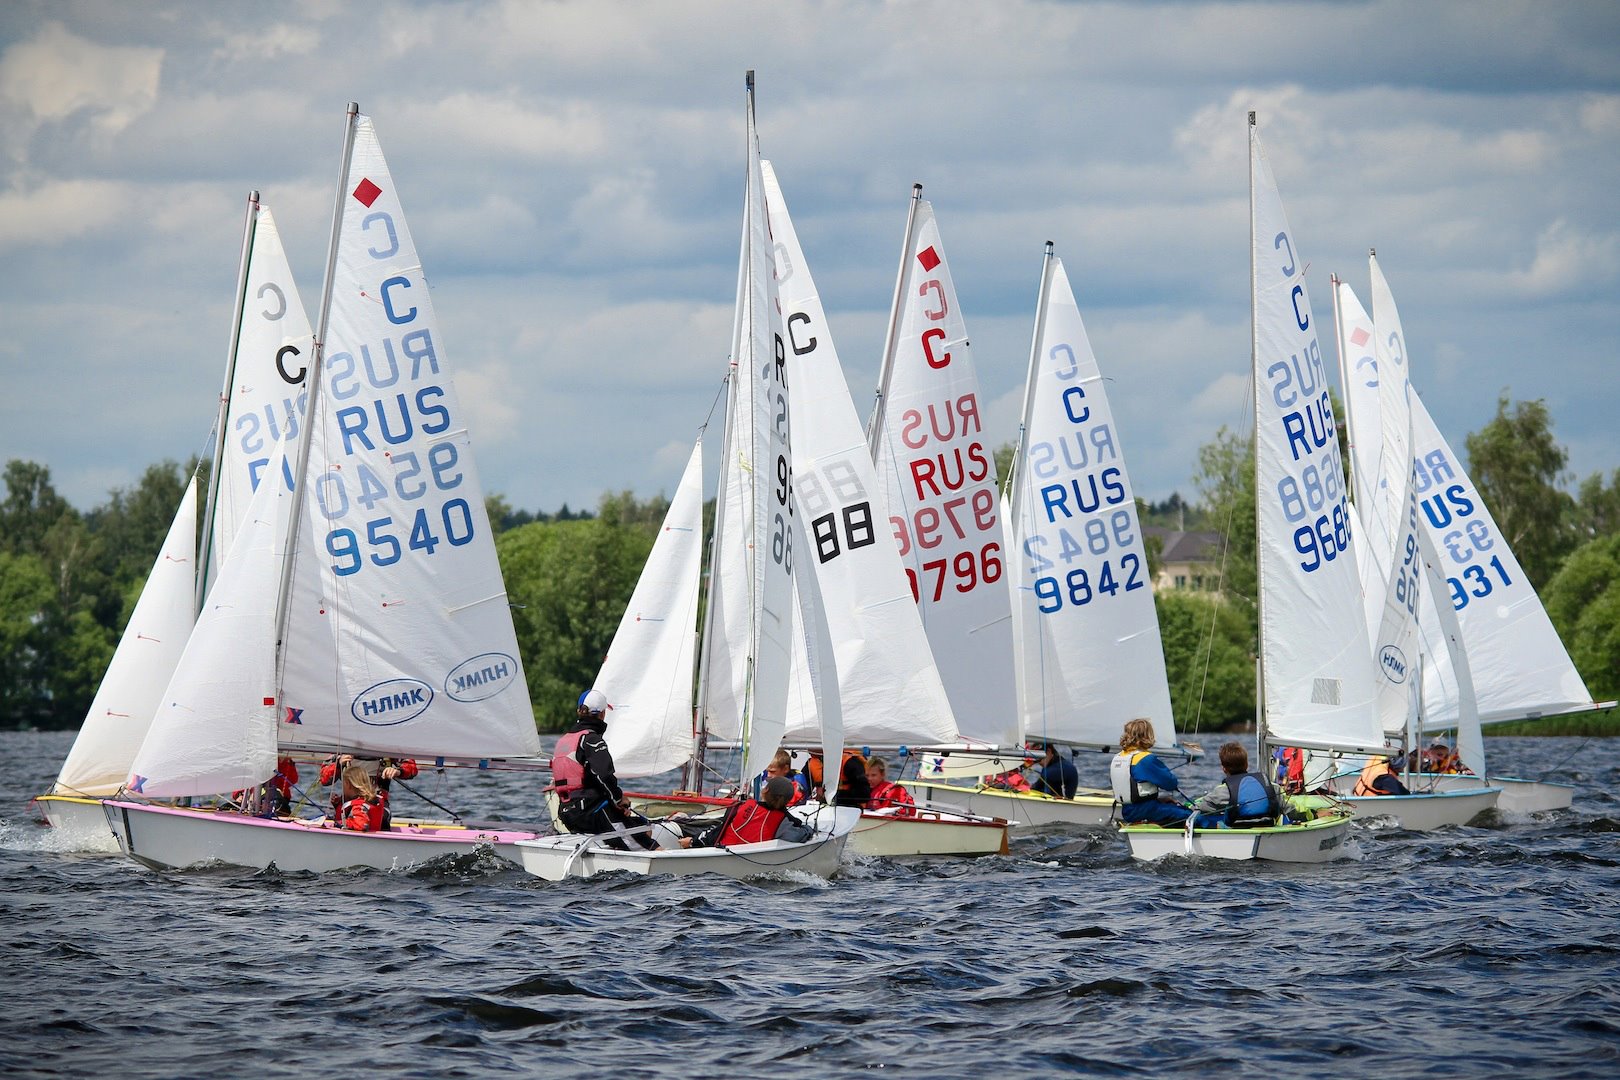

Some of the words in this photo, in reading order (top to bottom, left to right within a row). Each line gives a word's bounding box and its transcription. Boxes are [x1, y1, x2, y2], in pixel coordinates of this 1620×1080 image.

[380, 276, 417, 325] C
[1292, 285, 1309, 331] C
[787, 312, 817, 356] C
[921, 327, 951, 369] C
[276, 345, 307, 385] C
[336, 385, 450, 455] RUS
[1062, 386, 1090, 424] C
[1282, 391, 1334, 461] RUS
[910, 442, 988, 501] RUS
[1040, 467, 1125, 523] RUS
[1420, 485, 1475, 529] US
[325, 498, 474, 577] 9540
[1034, 553, 1144, 614] 9842
[362, 687, 425, 716] НЛМК
